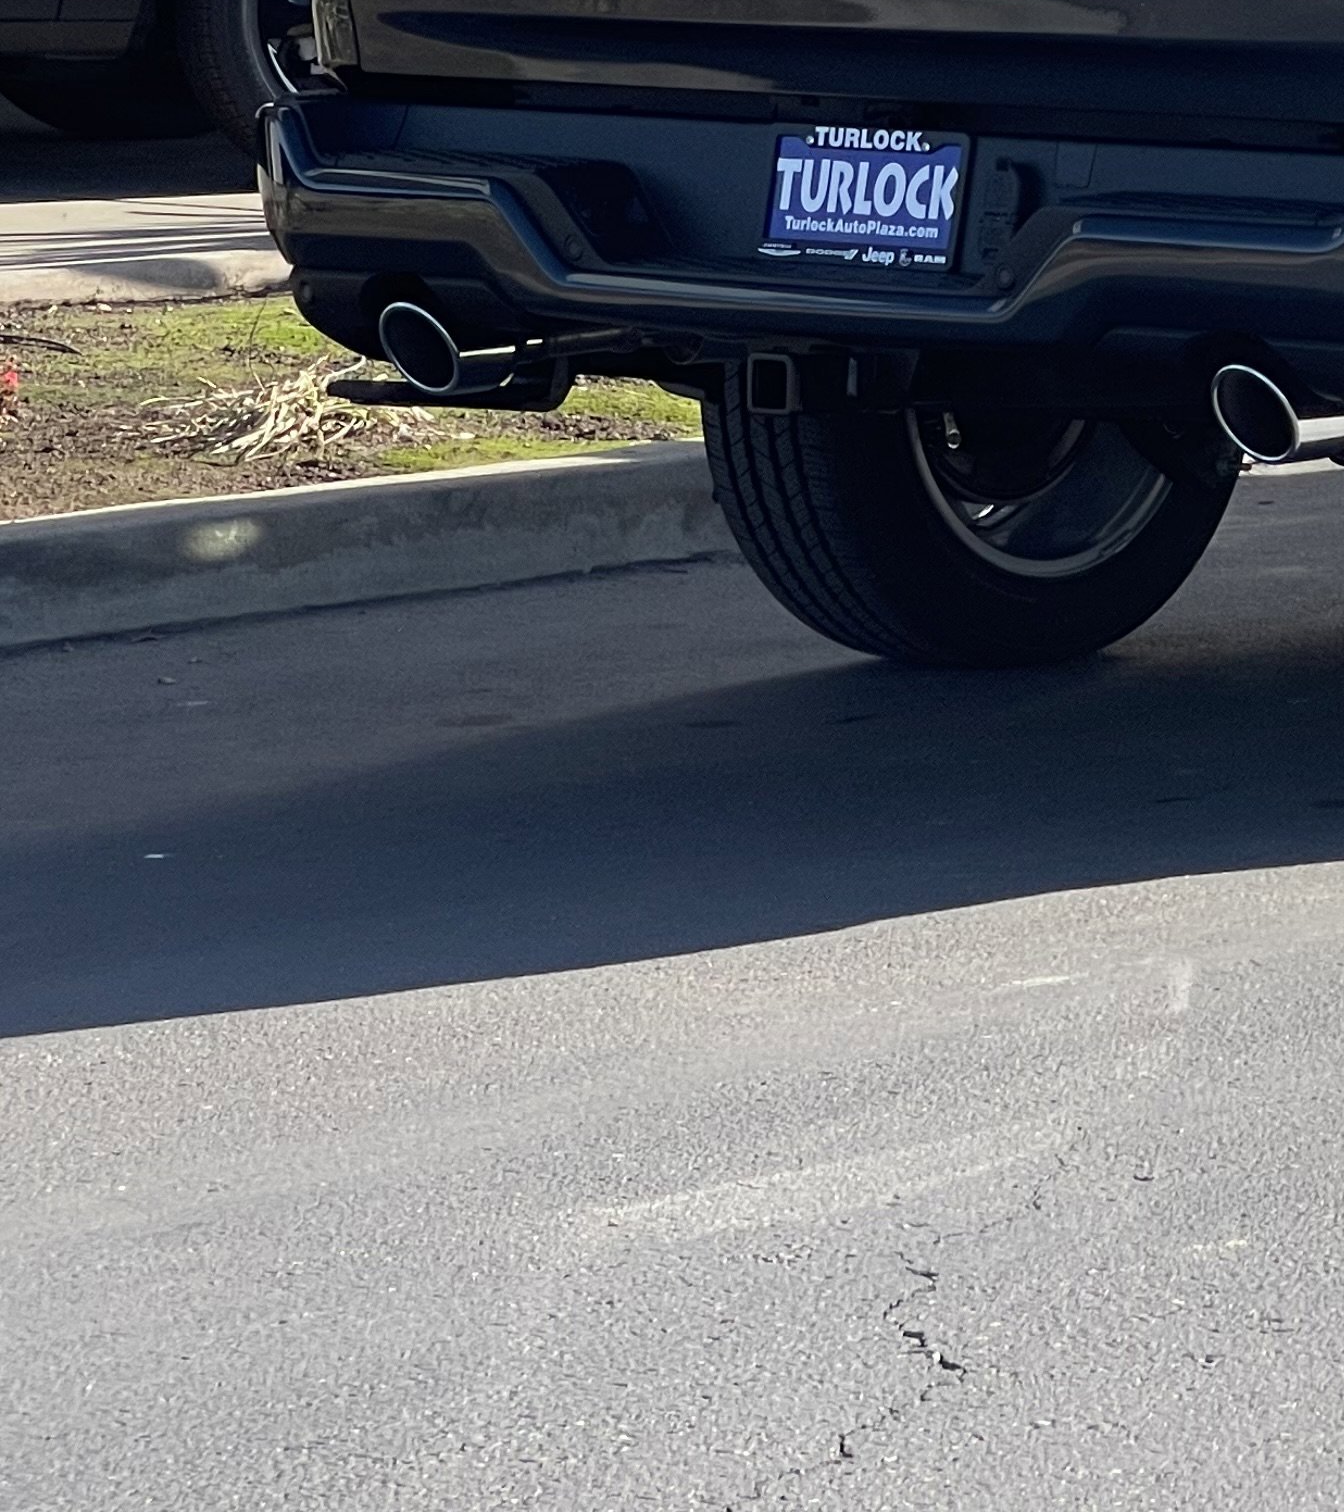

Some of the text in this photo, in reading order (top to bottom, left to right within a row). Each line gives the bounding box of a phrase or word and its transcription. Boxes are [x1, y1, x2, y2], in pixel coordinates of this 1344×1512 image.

[815, 126, 923, 151] TURLOCK
[777, 157, 959, 221] TURLOCK
[785, 215, 938, 239] TurlockAutoPlaza.com
[862, 246, 895, 266] Jeep
